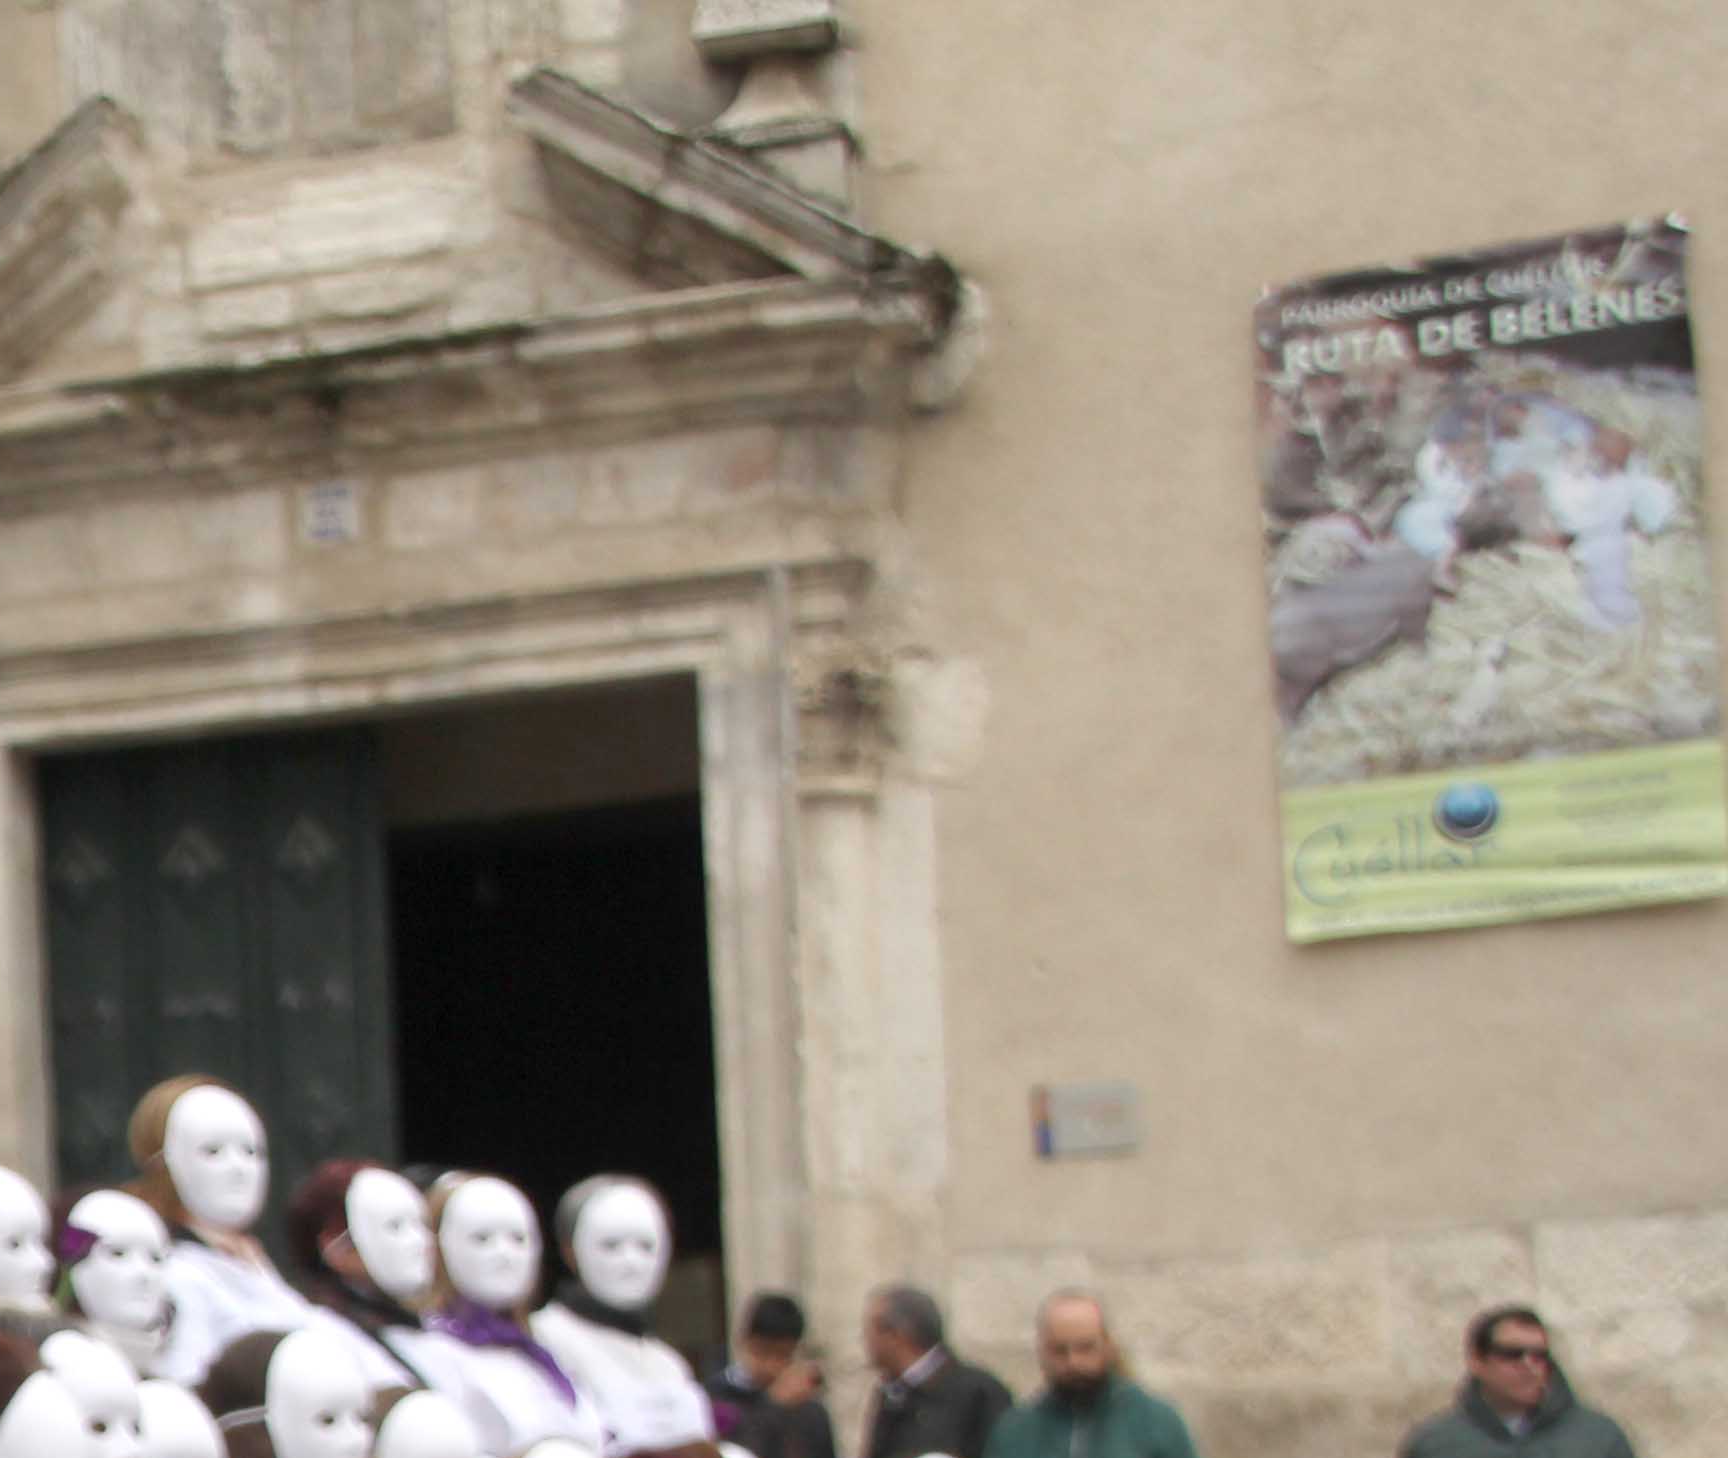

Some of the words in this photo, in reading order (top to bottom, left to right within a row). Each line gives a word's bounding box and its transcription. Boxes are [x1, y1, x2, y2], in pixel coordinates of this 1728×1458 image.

[1281, 285, 1438, 326] PARROQUIA
[1443, 275, 1483, 304] DE
[1282, 327, 1409, 377] RUTA
[1417, 313, 1485, 357] DE
[1490, 276, 1682, 345] BELENES
